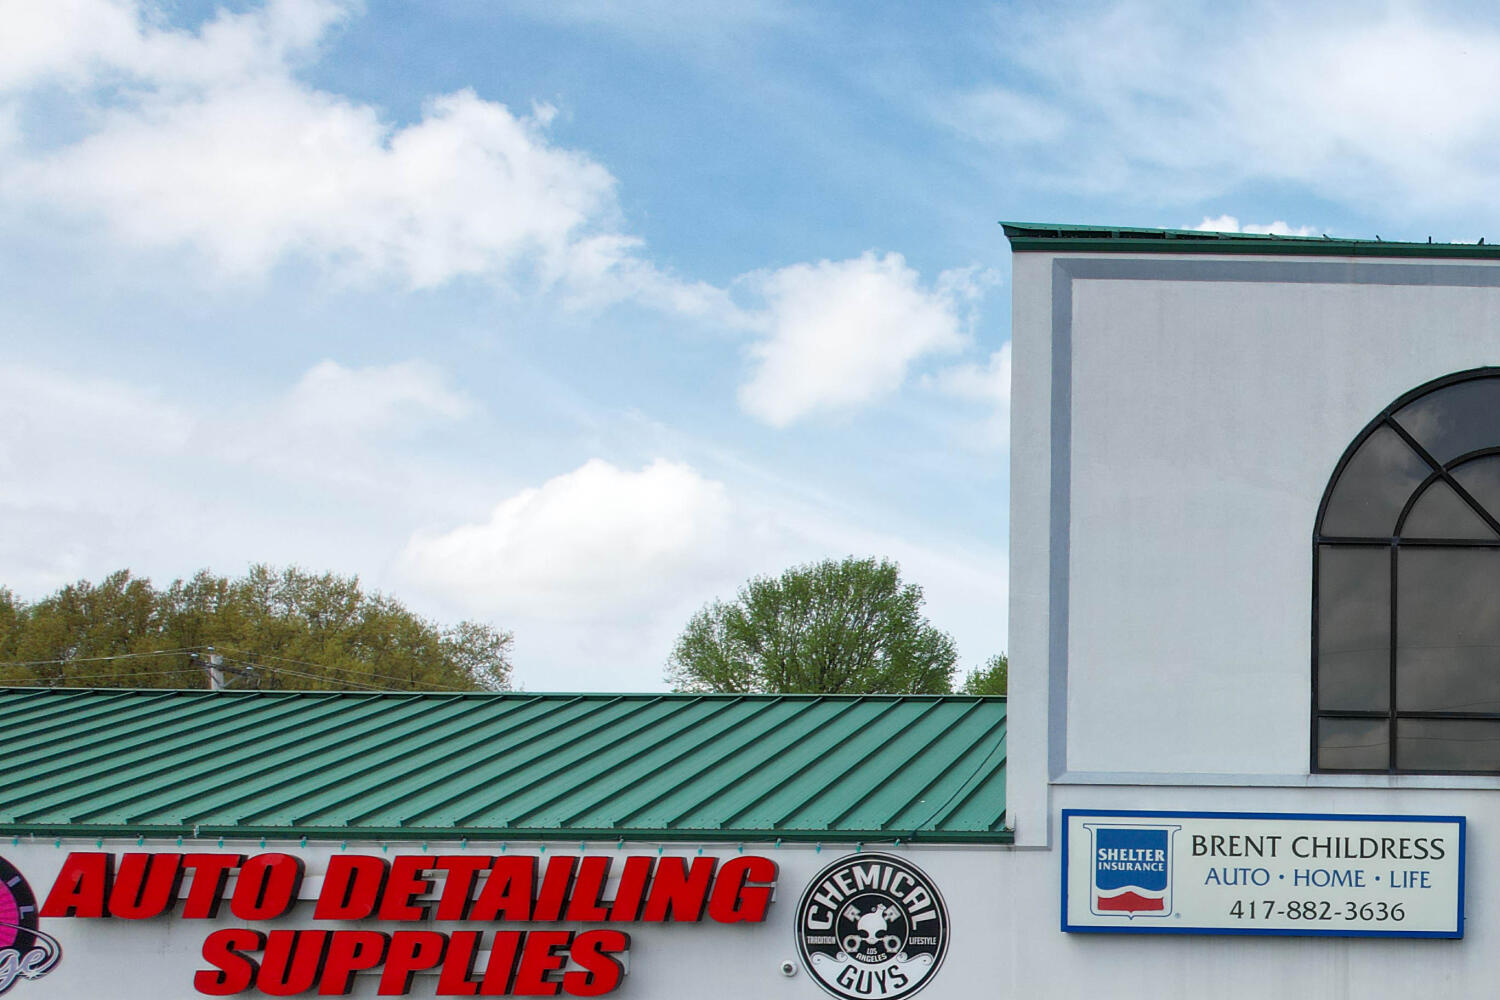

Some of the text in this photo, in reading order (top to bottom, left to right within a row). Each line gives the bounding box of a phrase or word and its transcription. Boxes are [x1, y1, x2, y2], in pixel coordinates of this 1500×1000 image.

[1098, 847, 1165, 862] SHELTER
[1192, 834, 1446, 860] BRENT CHILDRESS
[1098, 862, 1164, 873] INSURANCE
[1204, 867, 1432, 889] AUTO HOME LIFE
[39, 852, 779, 924] AUTO DETAILING
[807, 864, 937, 931] CHEMICAL
[1229, 900, 1406, 922] 417-882-3636
[807, 935, 836, 945] TRADITION
[866, 947, 878, 955] LOS
[909, 936, 937, 946] LIFESTYLE
[194, 928, 632, 997] SUPPLIES
[856, 952, 888, 963] ANGELES
[836, 964, 908, 995] GUYS
